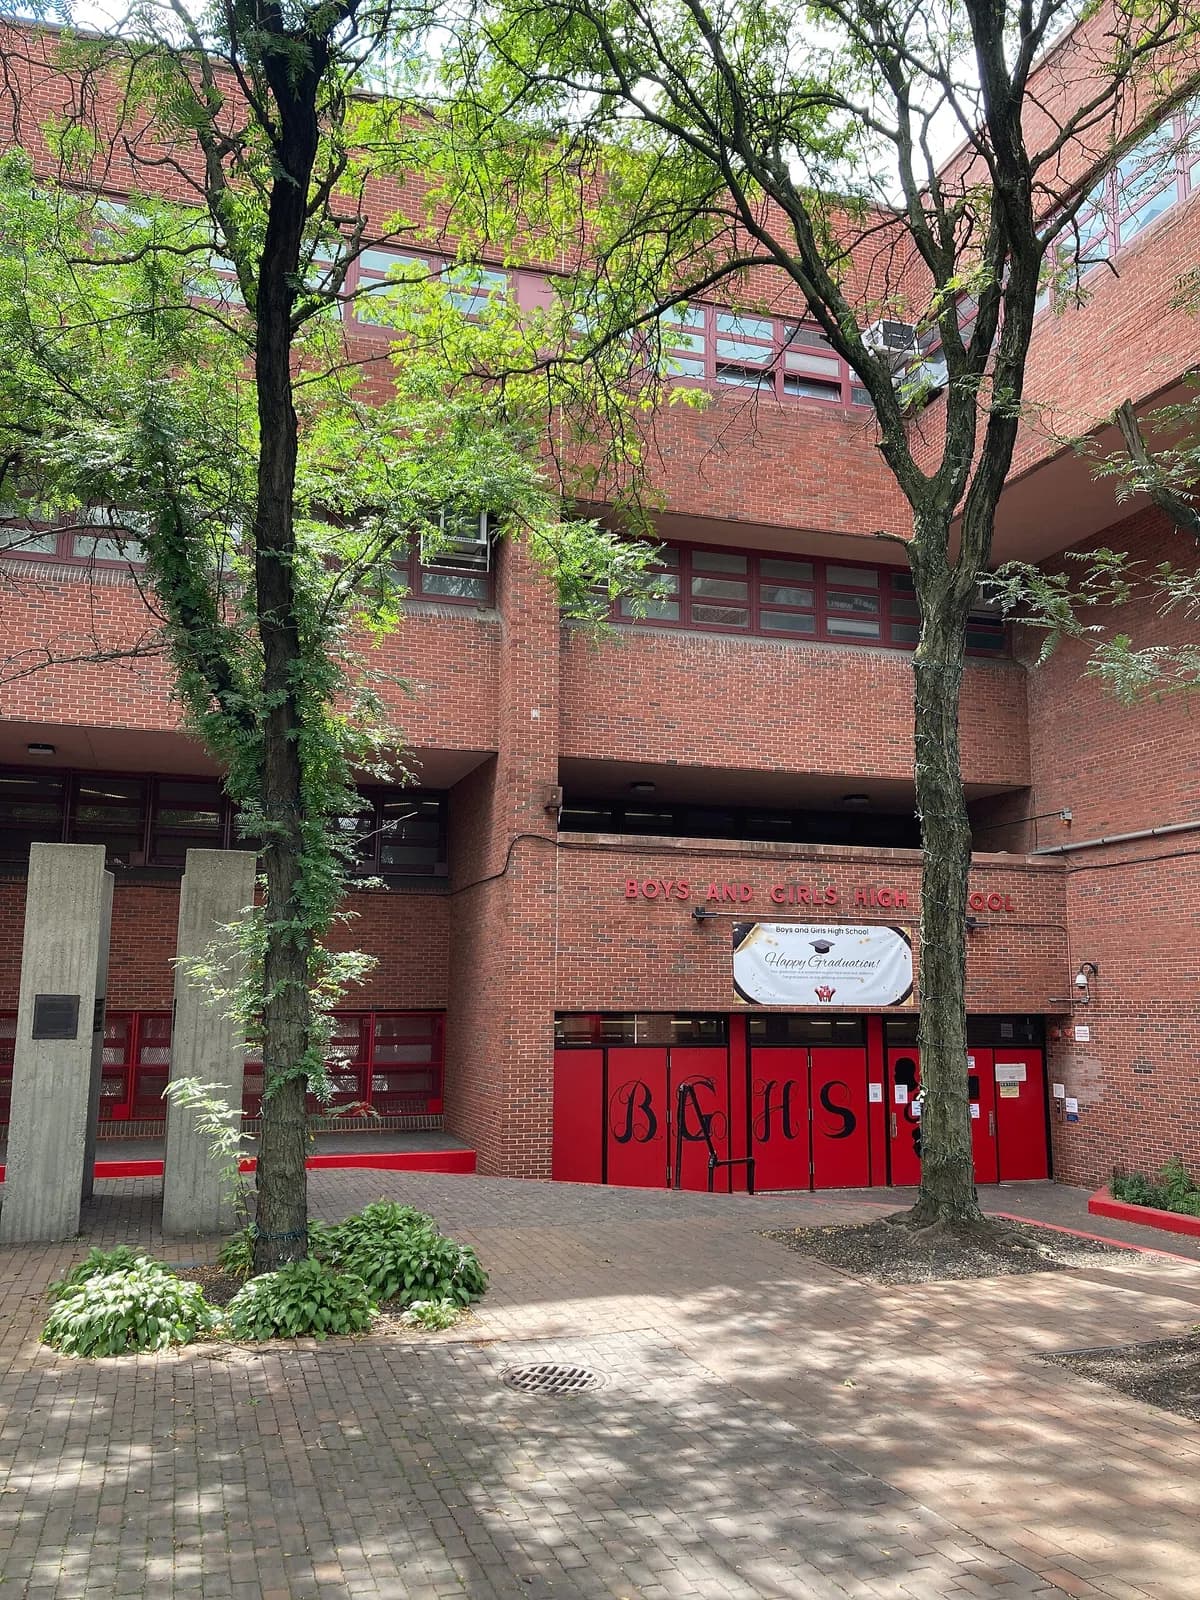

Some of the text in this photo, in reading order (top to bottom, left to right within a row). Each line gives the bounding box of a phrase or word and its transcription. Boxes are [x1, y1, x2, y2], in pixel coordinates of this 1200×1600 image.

[625, 879, 689, 899] BOYS
[706, 882, 752, 902] AND
[770, 884, 838, 905] GIRLS
[854, 887, 909, 908] HIGH
[775, 926, 793, 935] Boys
[827, 928, 844, 936] High
[764, 951, 881, 969] Happy Graduation!
